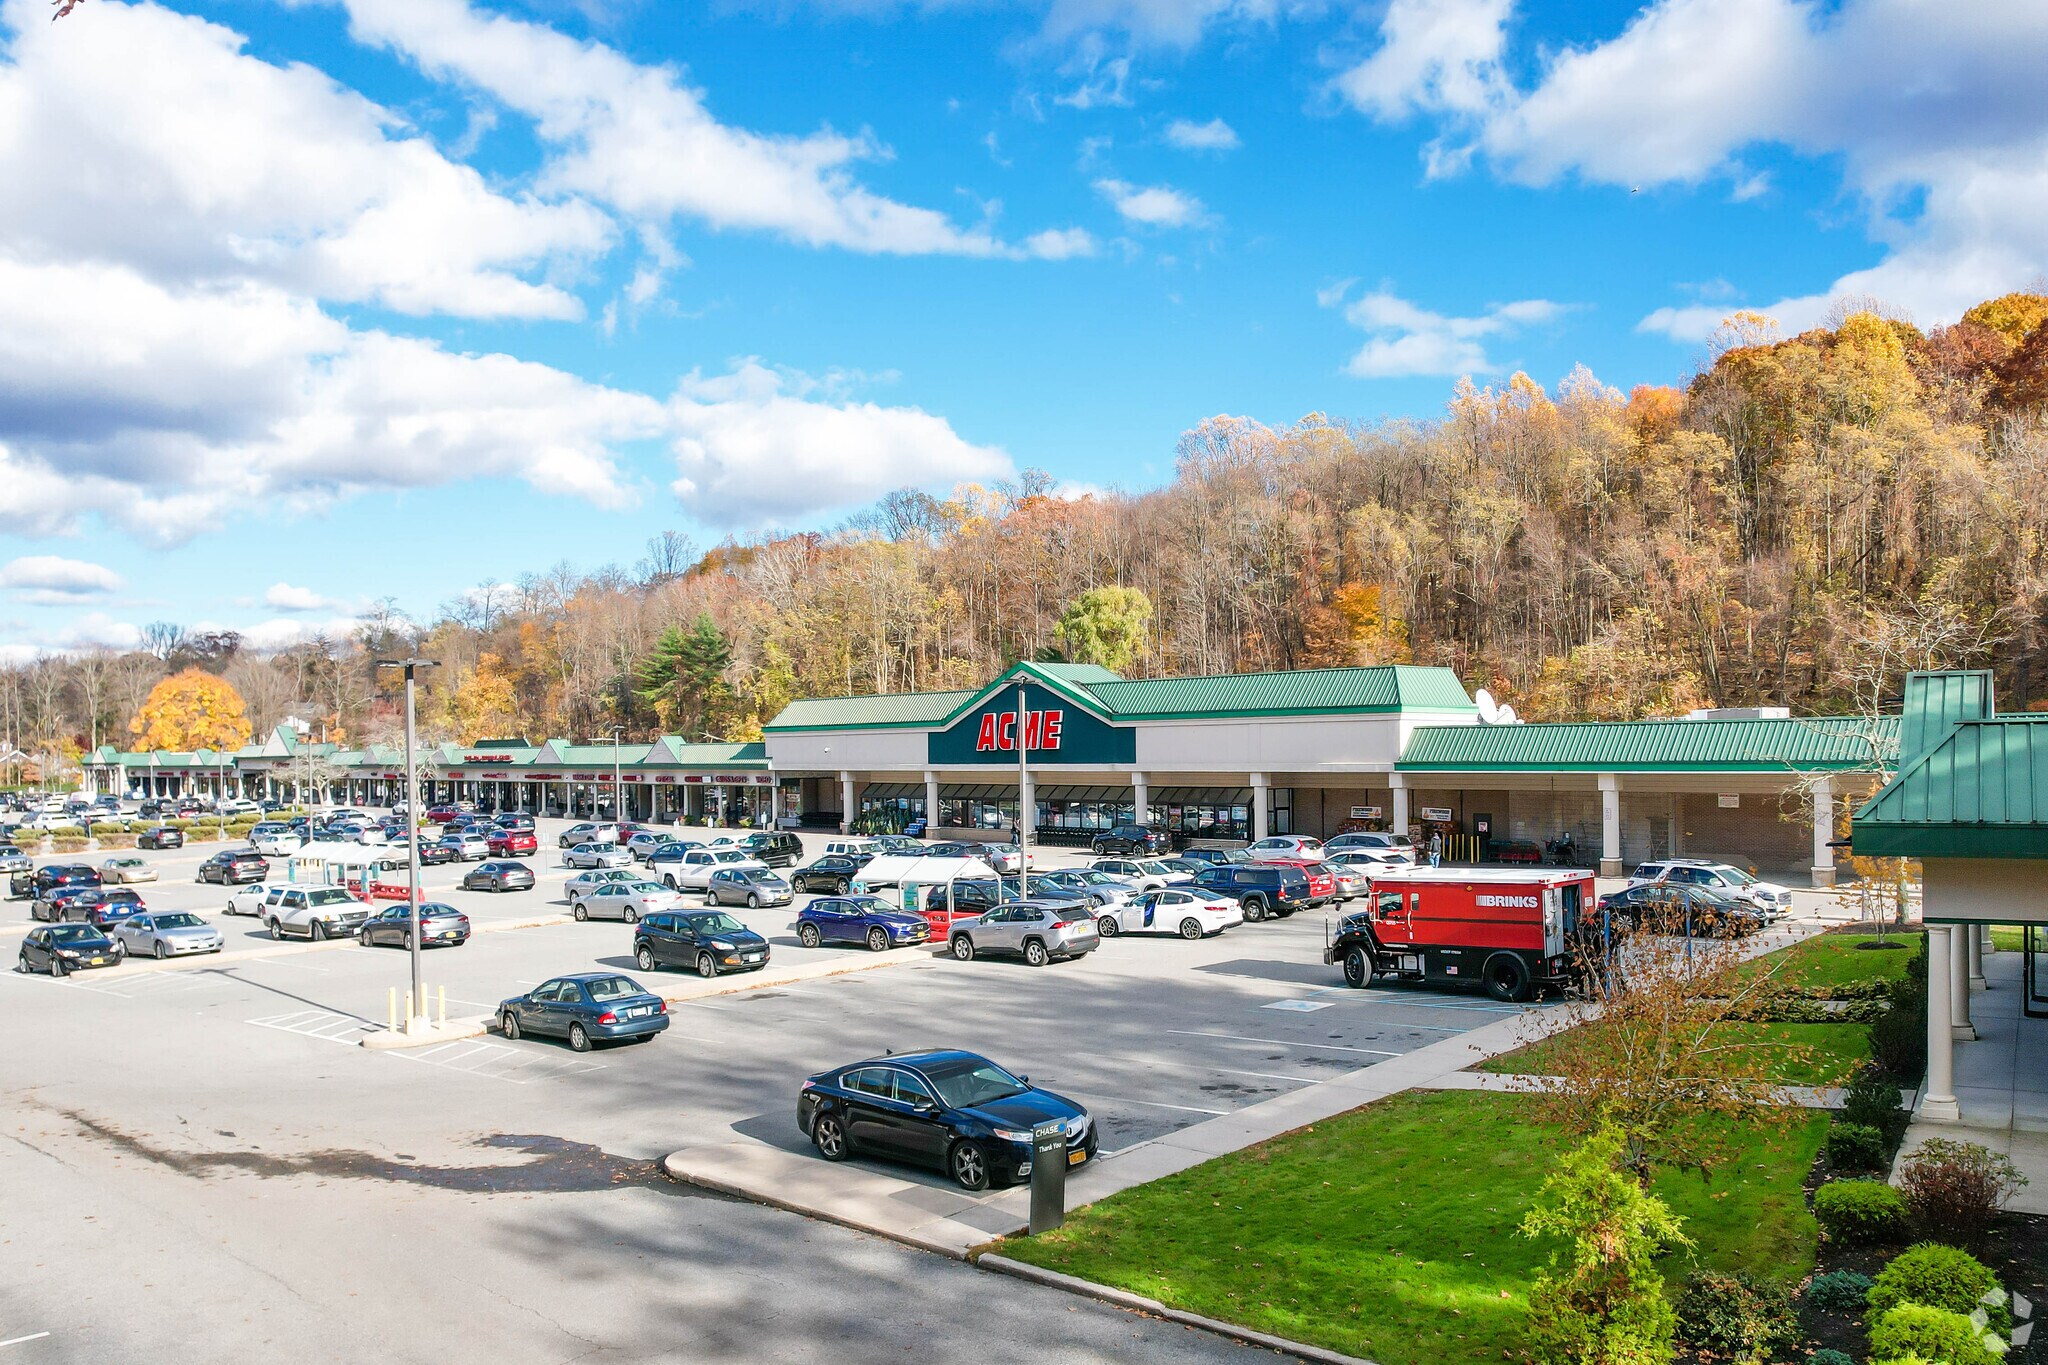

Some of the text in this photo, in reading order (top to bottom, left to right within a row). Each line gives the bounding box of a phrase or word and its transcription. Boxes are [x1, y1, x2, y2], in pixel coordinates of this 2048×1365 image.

[976, 710, 1063, 751] ACME
[1486, 895, 1538, 908] BRINKS
[1035, 1124, 1059, 1137] CHASE
[1039, 1142, 1062, 1153] Thank You
